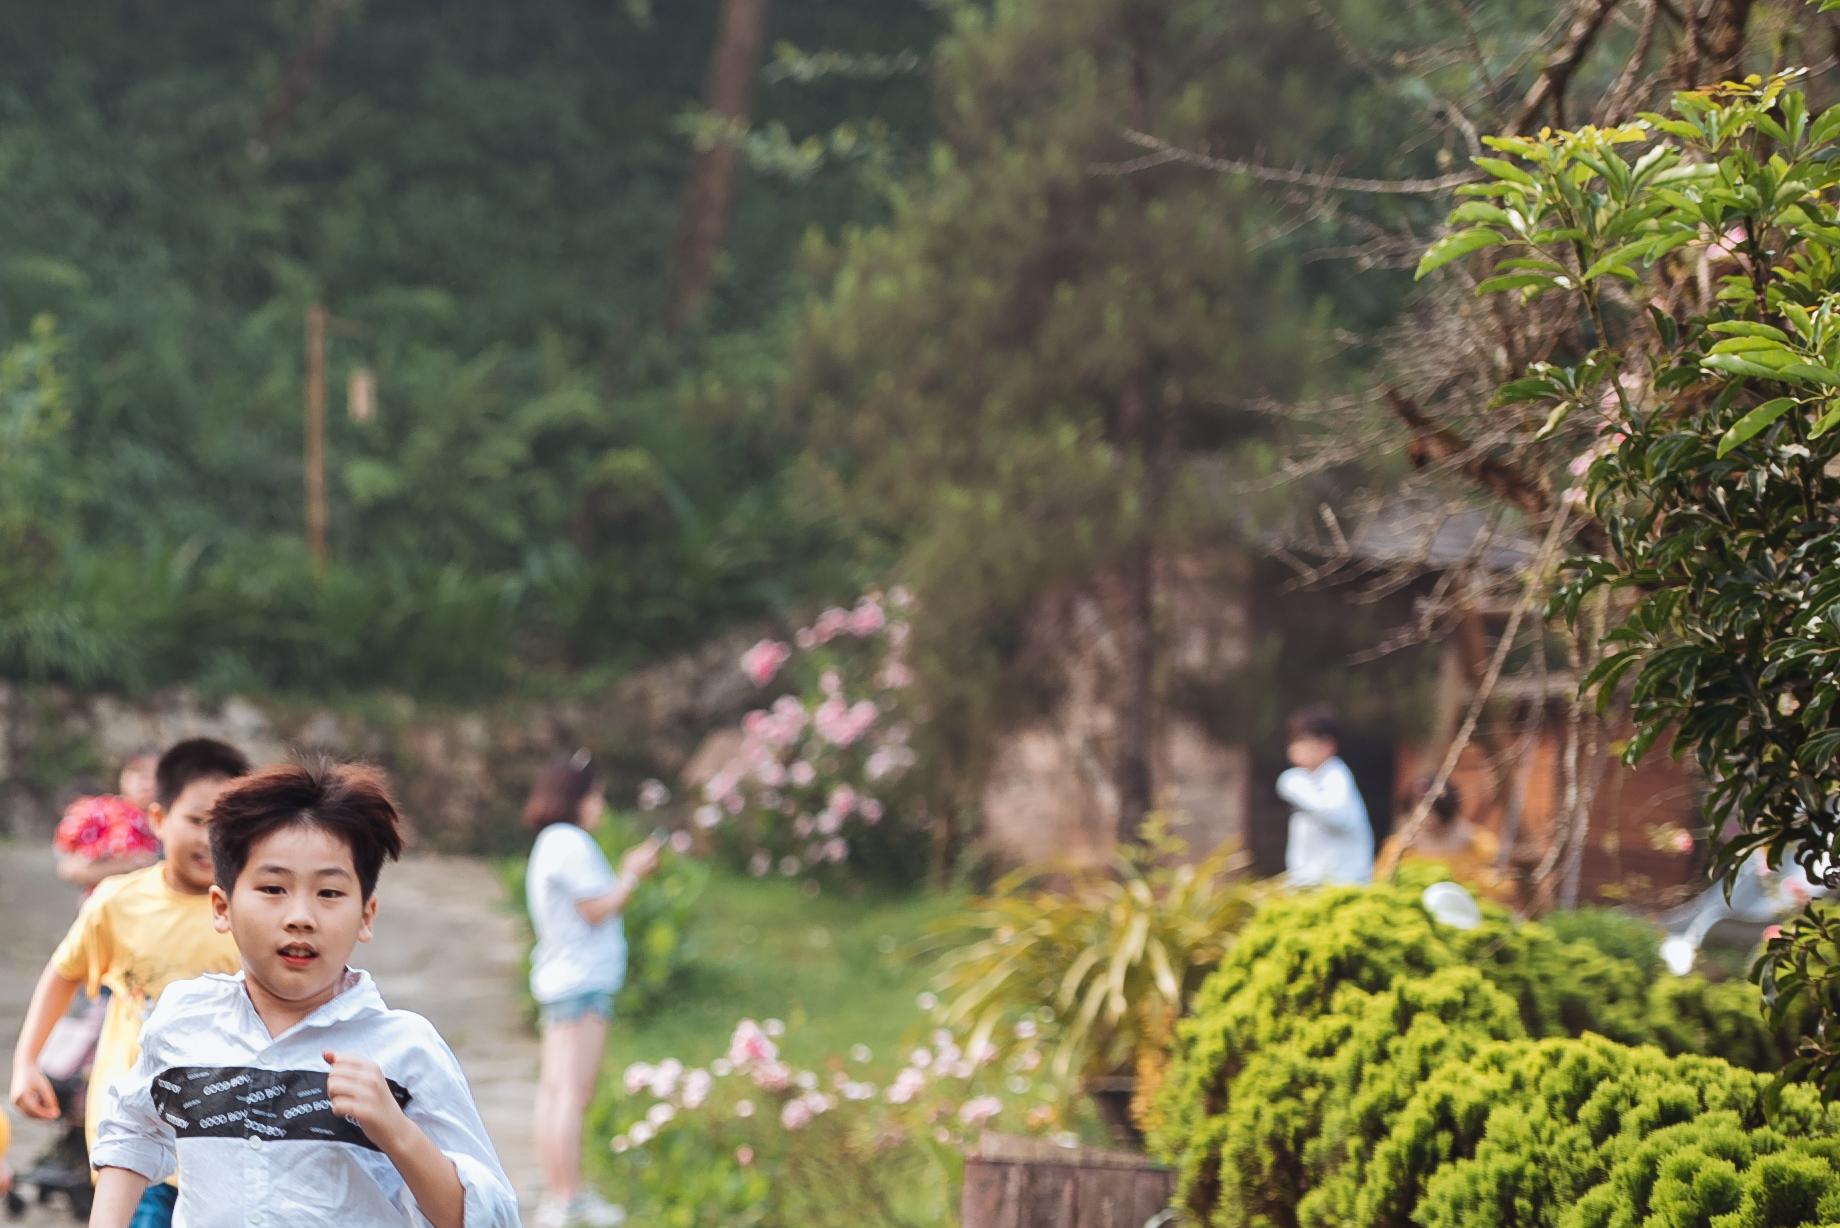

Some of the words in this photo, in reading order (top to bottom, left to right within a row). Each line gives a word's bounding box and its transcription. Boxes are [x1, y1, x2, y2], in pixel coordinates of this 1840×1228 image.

[203, 1080, 231, 1095] GOOD
[230, 1074, 251, 1087] BOY
[264, 1083, 287, 1098] BOY
[199, 1114, 227, 1128] GOOD
[226, 1109, 248, 1122] BOY
[283, 1103, 313, 1119] GOOD
